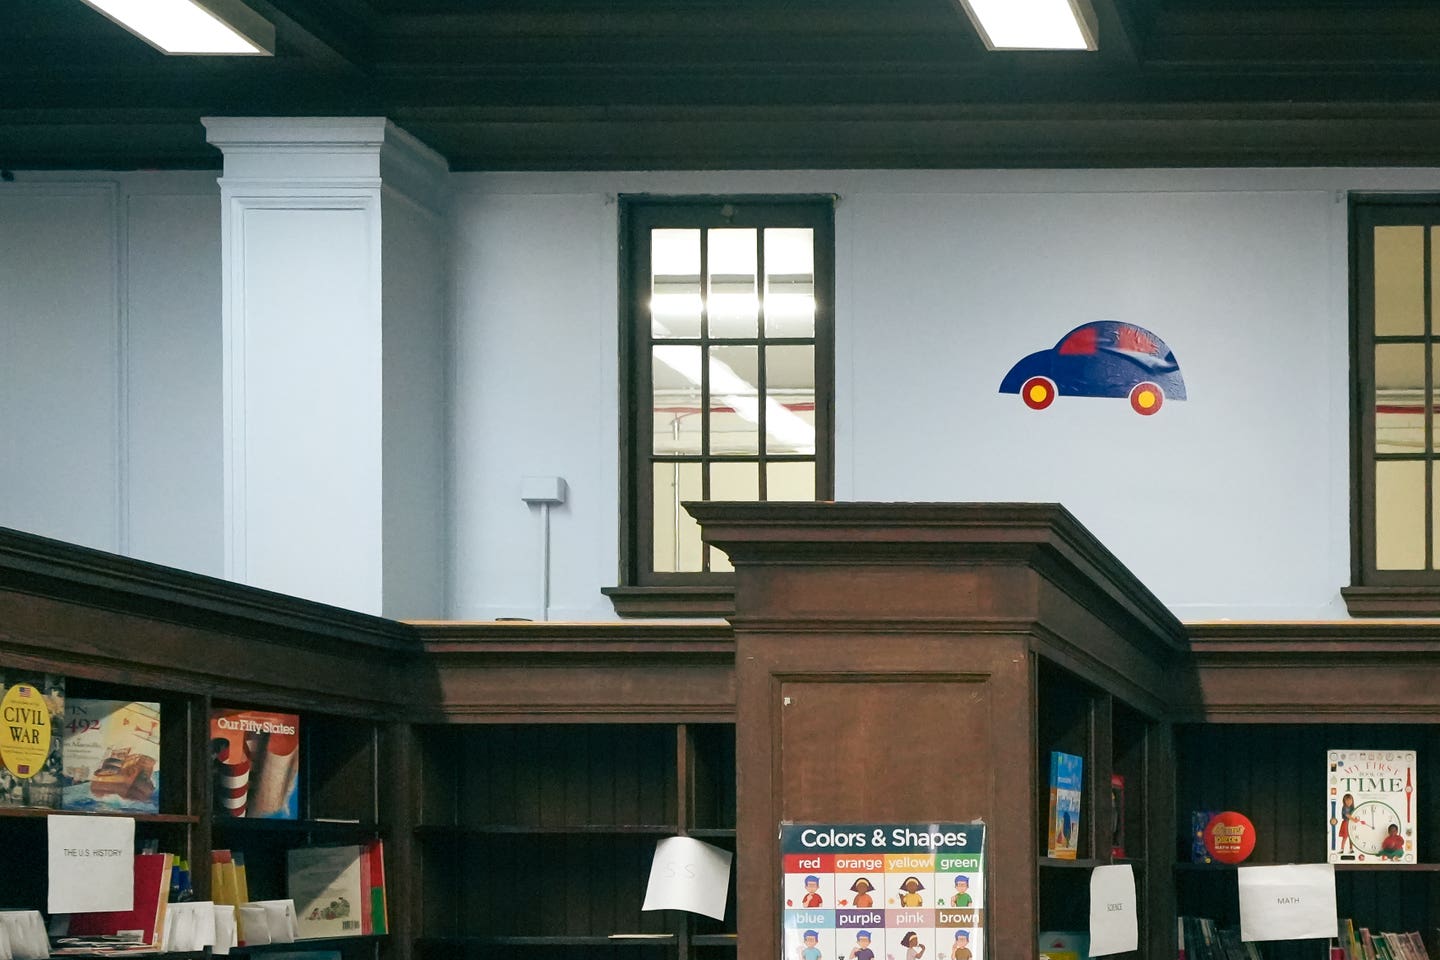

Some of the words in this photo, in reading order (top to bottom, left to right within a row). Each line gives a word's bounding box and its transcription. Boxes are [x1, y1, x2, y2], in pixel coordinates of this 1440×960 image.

[4, 707, 45, 726] CIVIL
[65, 718, 100, 733] 492
[217, 717, 238, 729] Our
[240, 719, 262, 734] Fifty
[263, 722, 295, 735] States
[9, 726, 40, 744] WAR
[1344, 764, 1361, 776] MY
[1366, 761, 1400, 776] FIRST
[1340, 777, 1404, 793] TIME
[801, 829, 866, 848] Colors
[871, 829, 886, 848] &
[892, 829, 967, 850] Shapes
[63, 848, 78, 857] THE
[93, 848, 122, 857] HISTORY
[799, 857, 821, 869] red
[837, 858, 882, 871] orange
[889, 856, 930, 870] yellow
[940, 857, 978, 870] green
[1277, 897, 1300, 905] MATH
[796, 912, 825, 924] blue
[839, 913, 881, 926] purple
[896, 912, 924, 925] pink
[939, 913, 979, 924] brown
